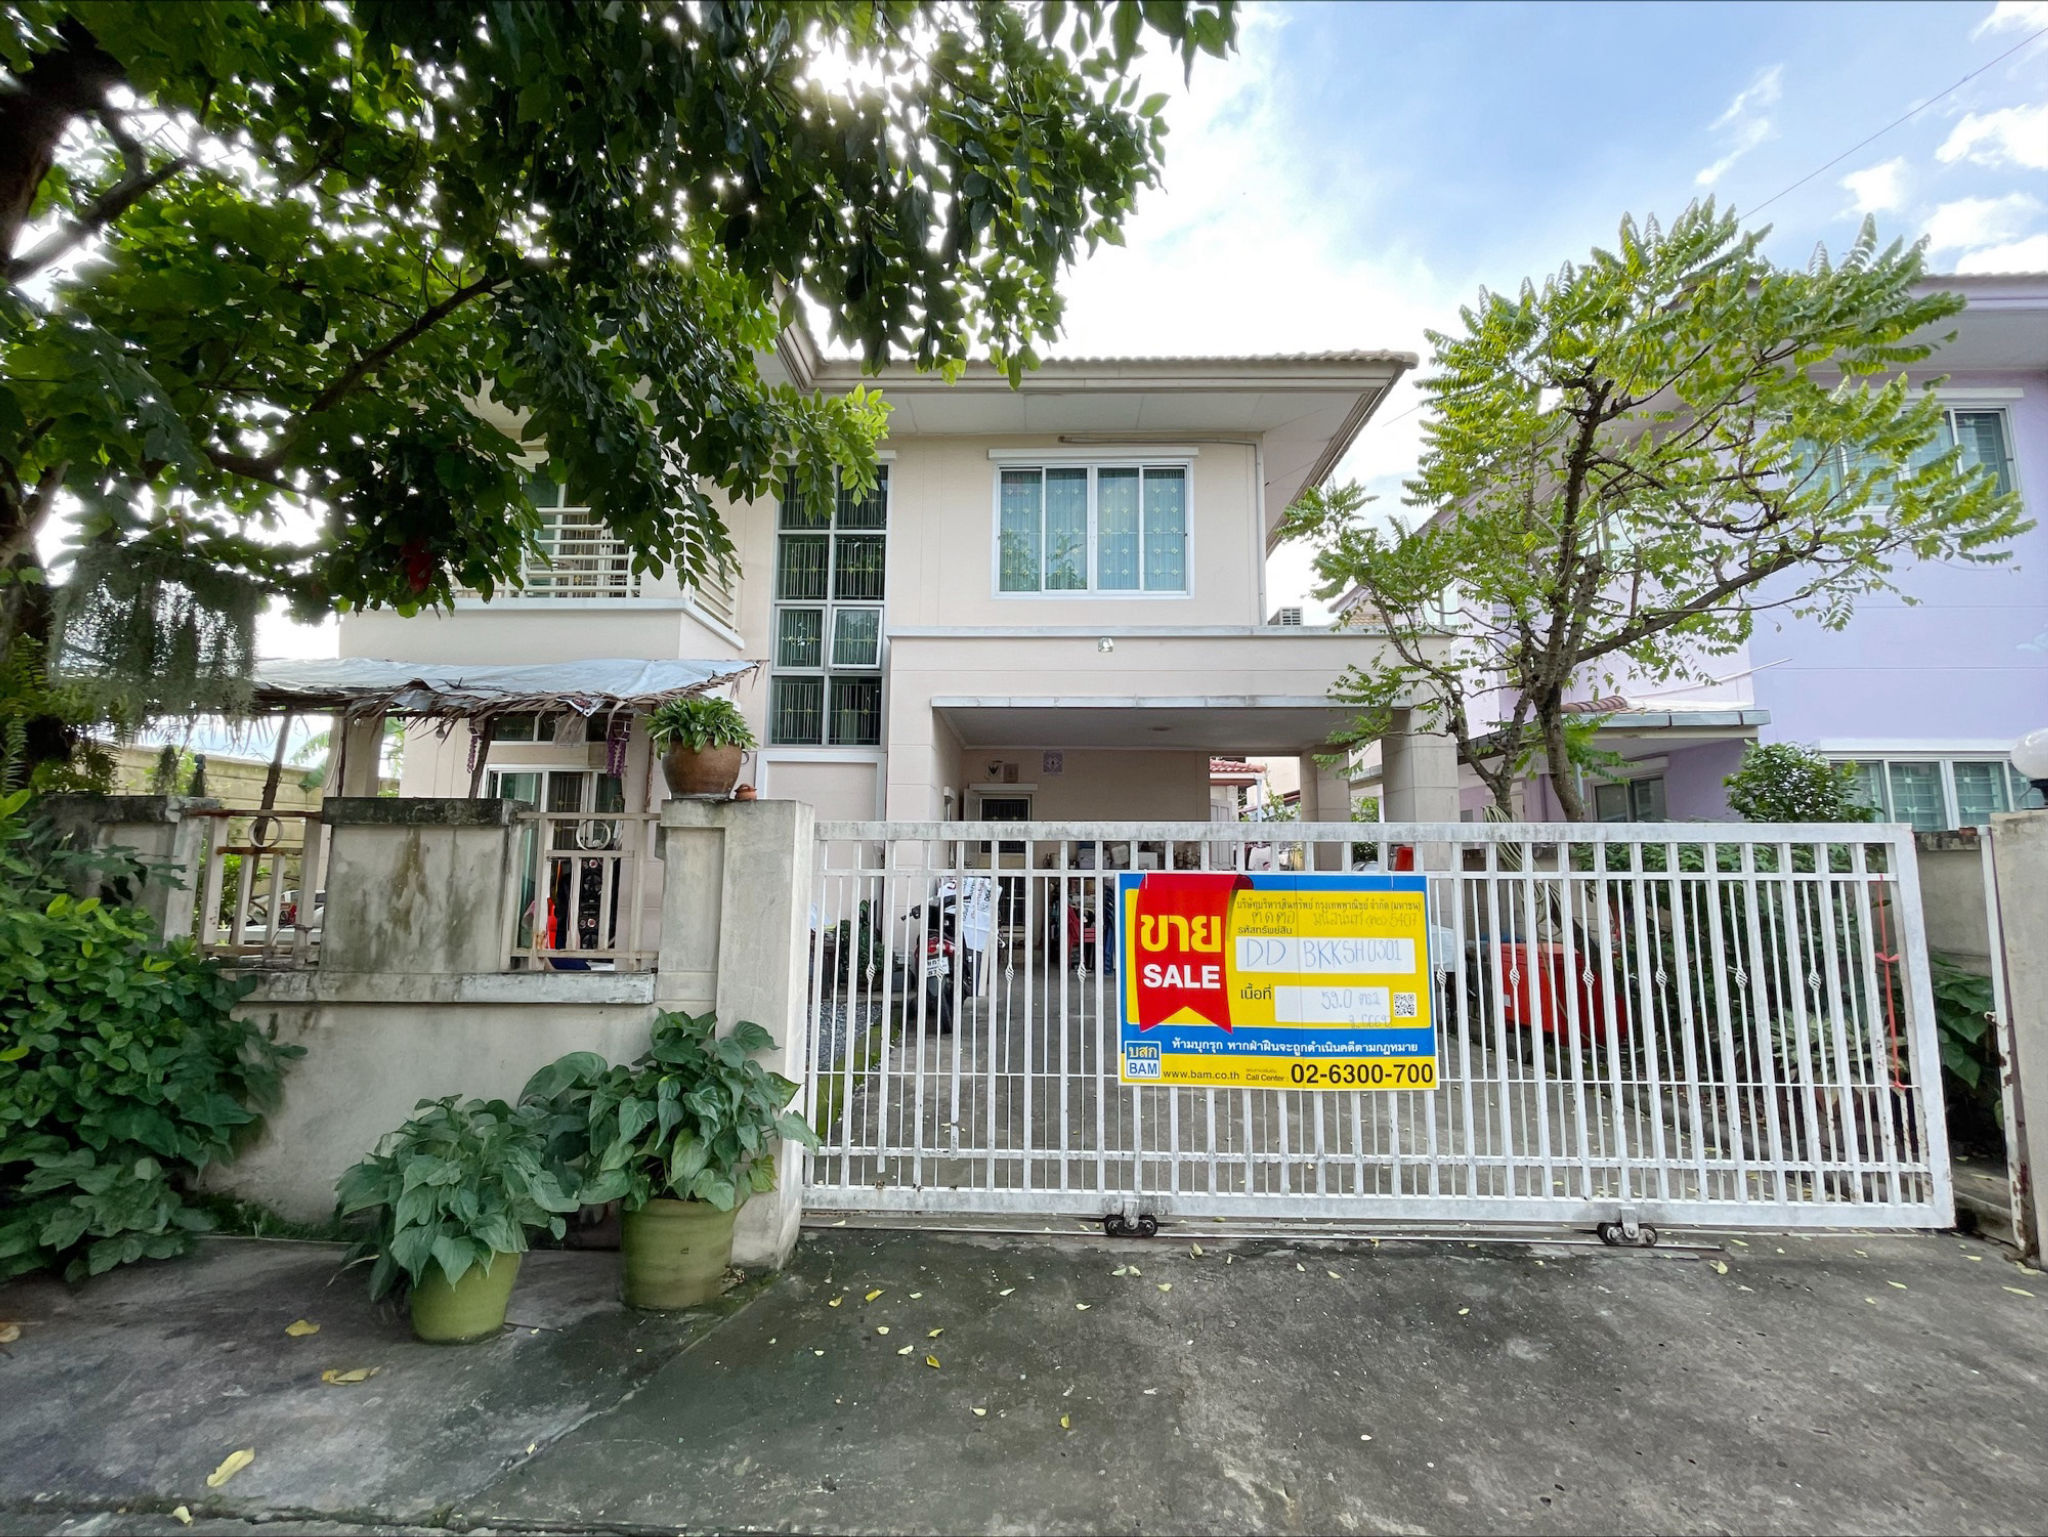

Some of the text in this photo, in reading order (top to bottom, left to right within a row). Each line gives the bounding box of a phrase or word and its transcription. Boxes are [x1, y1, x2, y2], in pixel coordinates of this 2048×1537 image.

[1140, 914, 1221, 952] ขาย
[1143, 963, 1221, 989] SALE
[1240, 982, 1272, 1001] เนื้อที่
[1172, 1037, 1223, 1053] ห้ามบุกรุก
[1129, 1062, 1158, 1075] BAM
[1163, 1069, 1240, 1080] www.bam.co.th
[1246, 1073, 1261, 1081] Call
[1291, 1063, 1433, 1084] 02-6300-700
